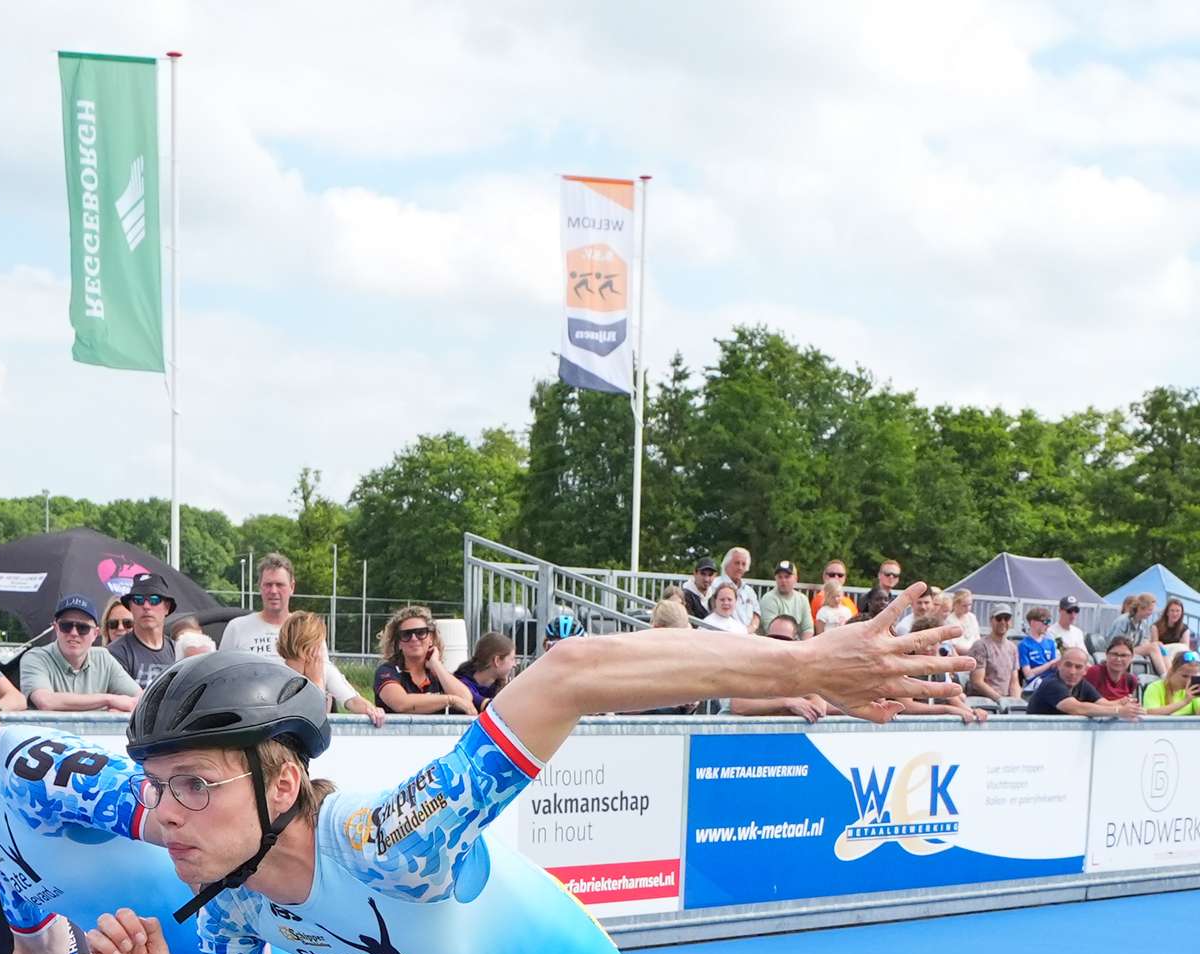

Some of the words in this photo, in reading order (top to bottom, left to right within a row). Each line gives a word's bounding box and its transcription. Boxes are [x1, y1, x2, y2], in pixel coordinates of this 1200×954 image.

[720, 765, 809, 779] METAALBEWERKING
[532, 790, 650, 816] vakmanschap
[375, 792, 448, 855] Bemiddeling
[531, 821, 547, 844] in
[554, 820, 593, 842] hout
[695, 817, 825, 844] www.wk-metaal.nl
